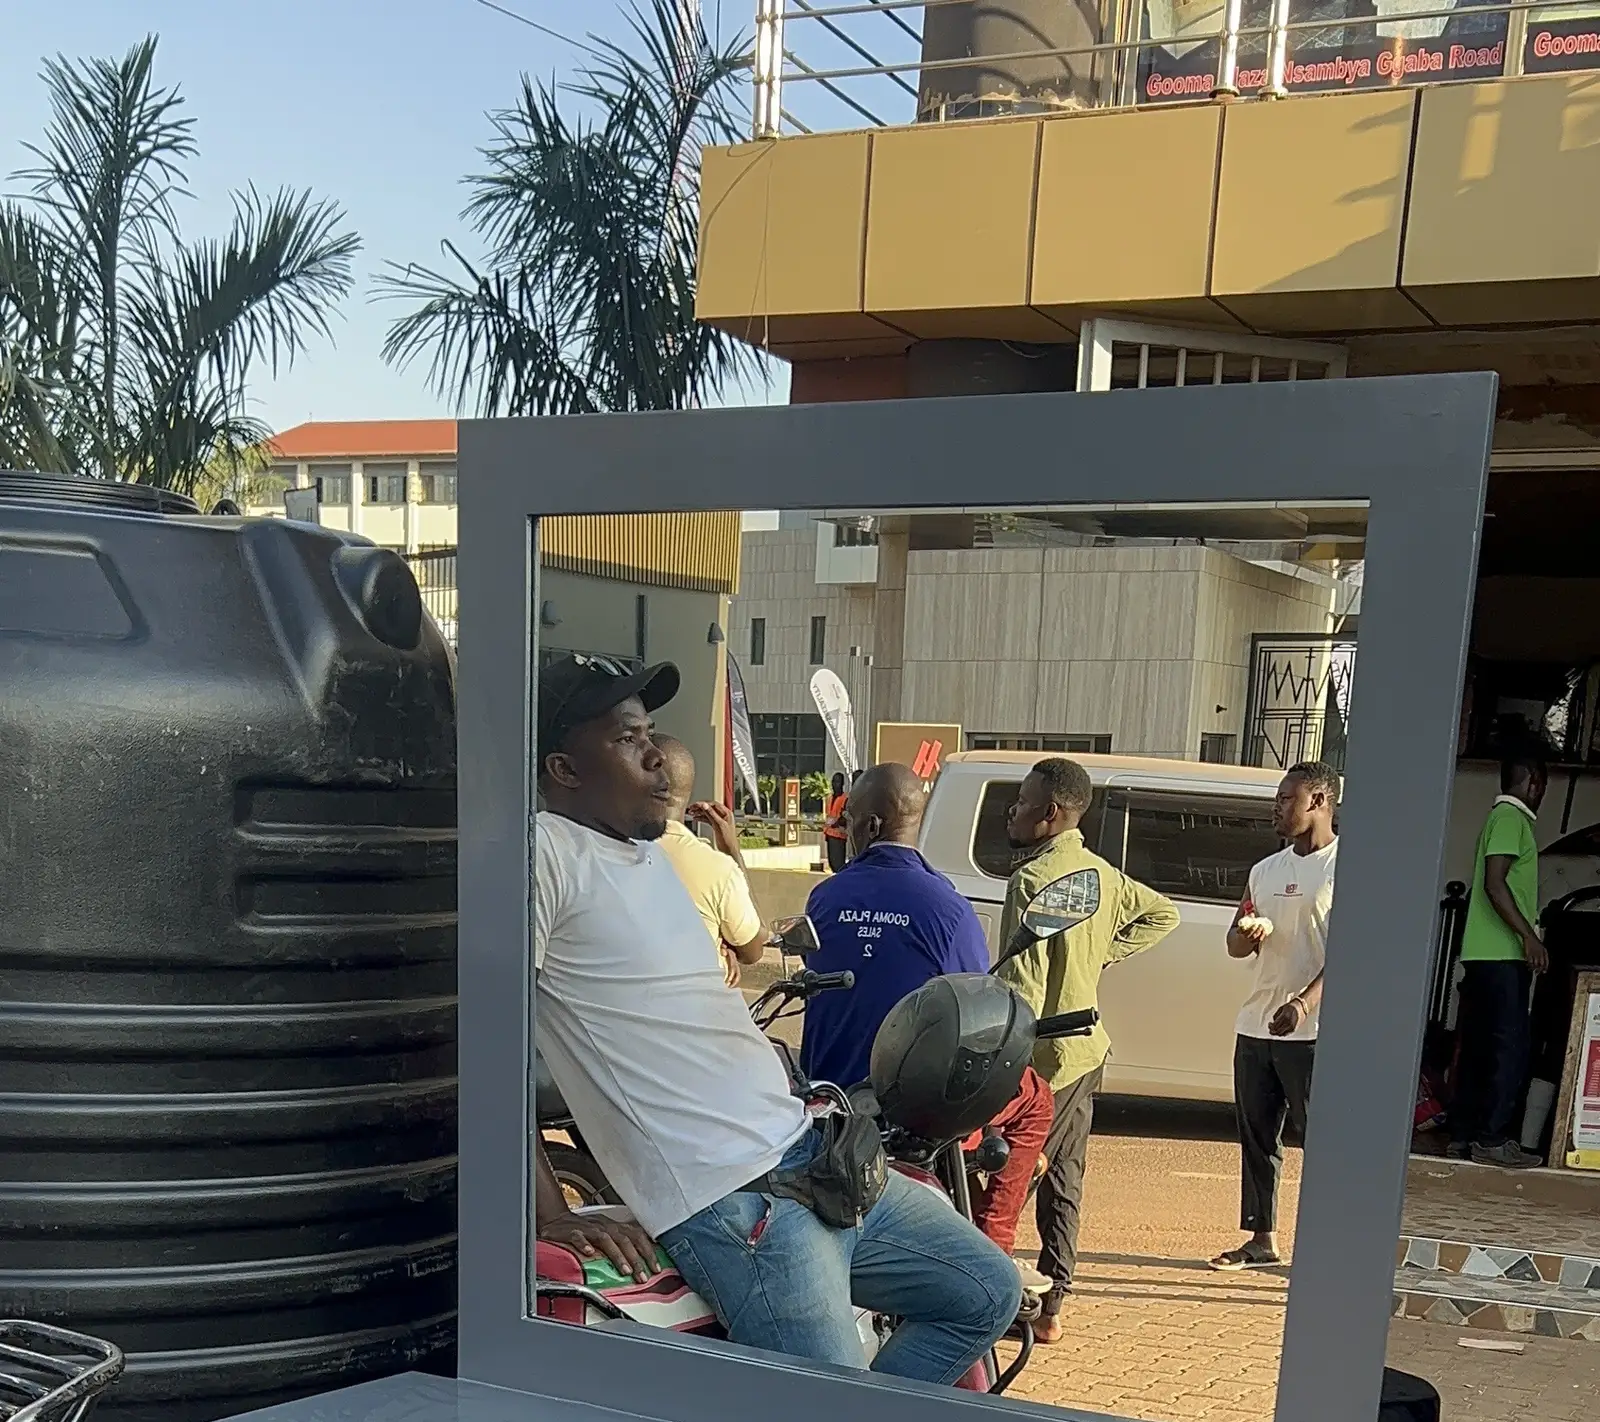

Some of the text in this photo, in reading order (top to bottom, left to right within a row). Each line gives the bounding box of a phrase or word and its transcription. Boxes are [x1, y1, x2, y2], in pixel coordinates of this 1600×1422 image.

[1534, 32, 1600, 57] Goom
[1146, 73, 1214, 96] Gooma
[1235, 66, 1268, 88] laza
[1448, 41, 1504, 68] Road
